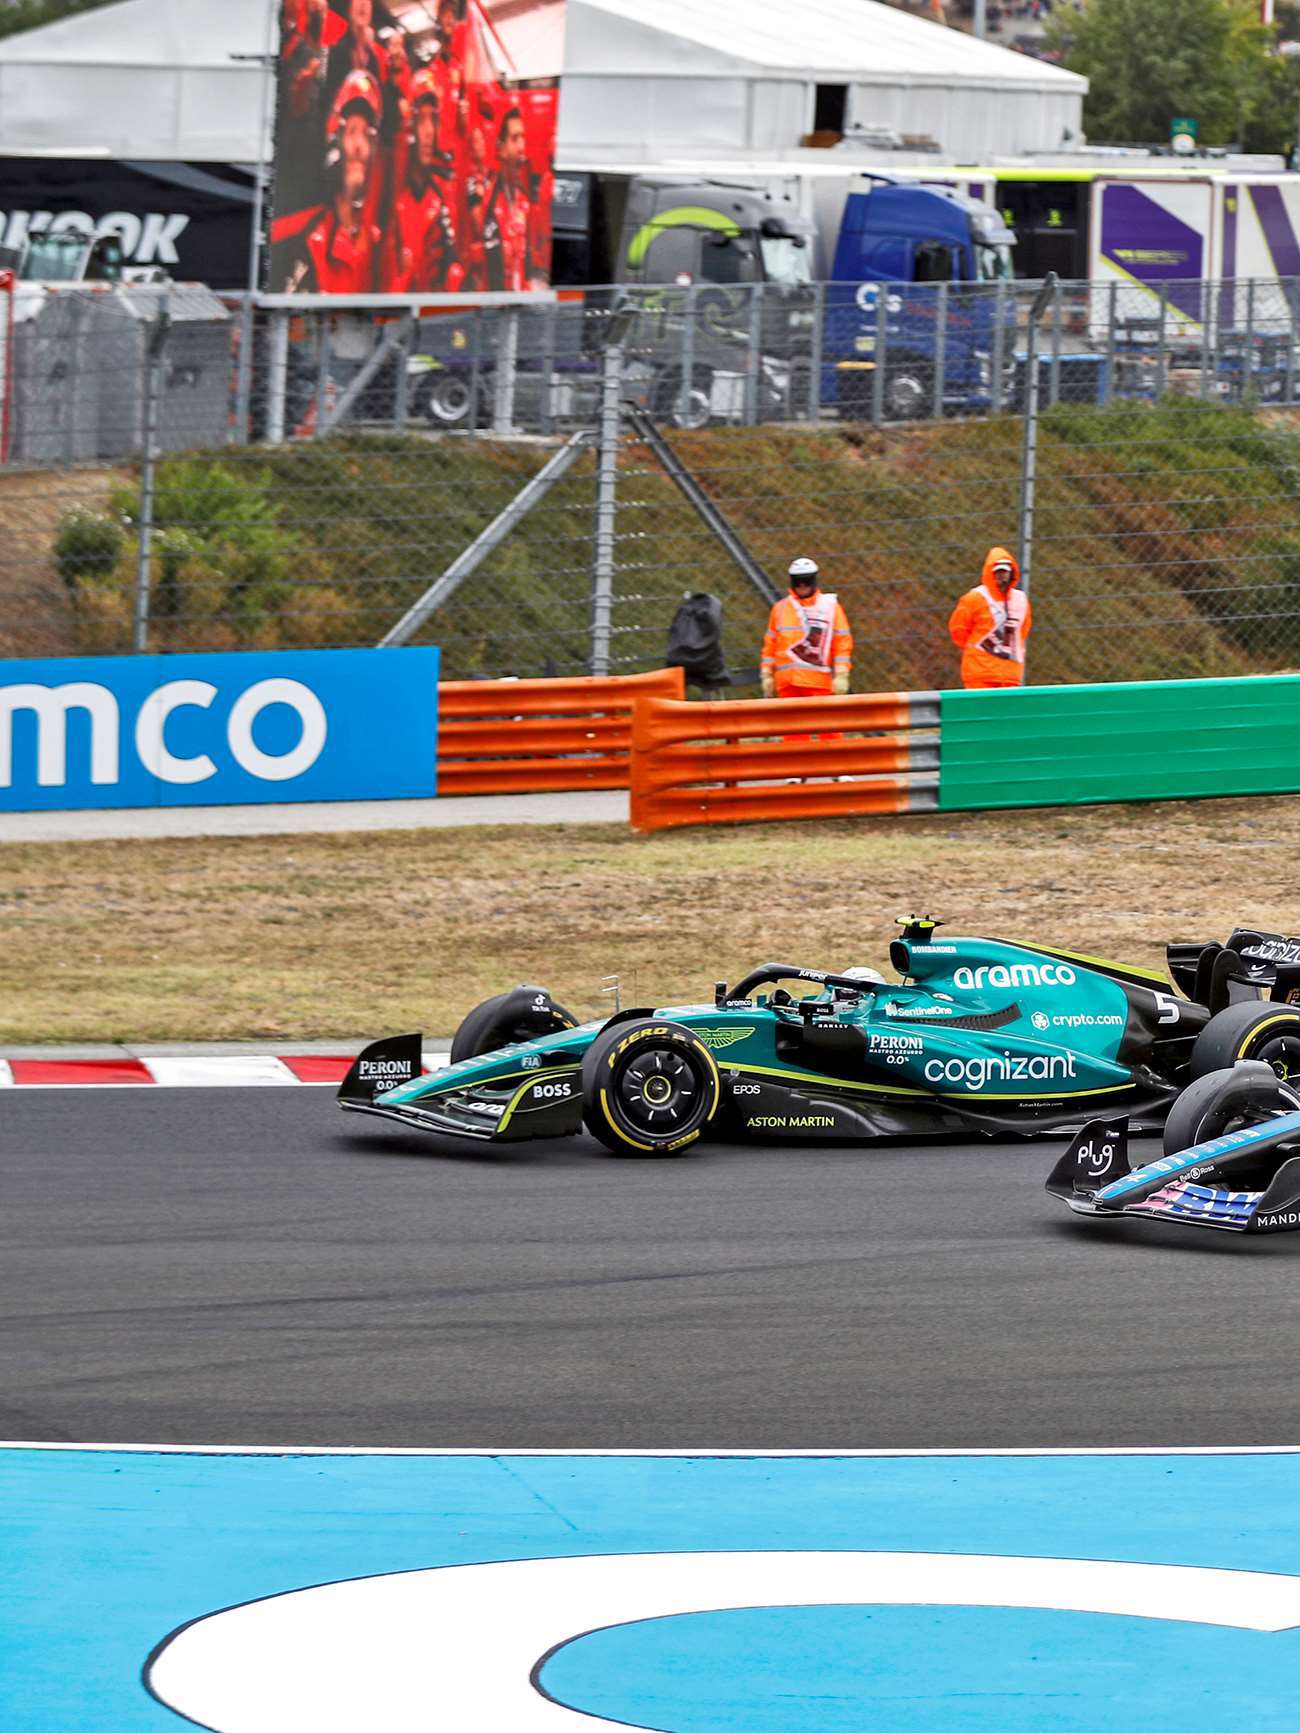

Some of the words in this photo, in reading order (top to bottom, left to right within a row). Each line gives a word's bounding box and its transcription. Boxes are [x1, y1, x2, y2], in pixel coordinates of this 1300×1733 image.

[954, 964, 1076, 990] aramco
[896, 1005, 953, 1016] SentinelOne
[1154, 992, 1180, 1024] 5
[1052, 1013, 1123, 1028] crypto.com
[618, 1027, 669, 1053] ZERO
[870, 1034, 923, 1049] PERONI
[359, 1060, 411, 1074] PERONI
[925, 1051, 1077, 1091] cognizant
[533, 1083, 571, 1098] BOSS
[733, 1084, 760, 1095] EPOS
[747, 1116, 786, 1127] ASTON
[789, 1116, 835, 1127] MARTIN
[1077, 1140, 1113, 1177] plug
